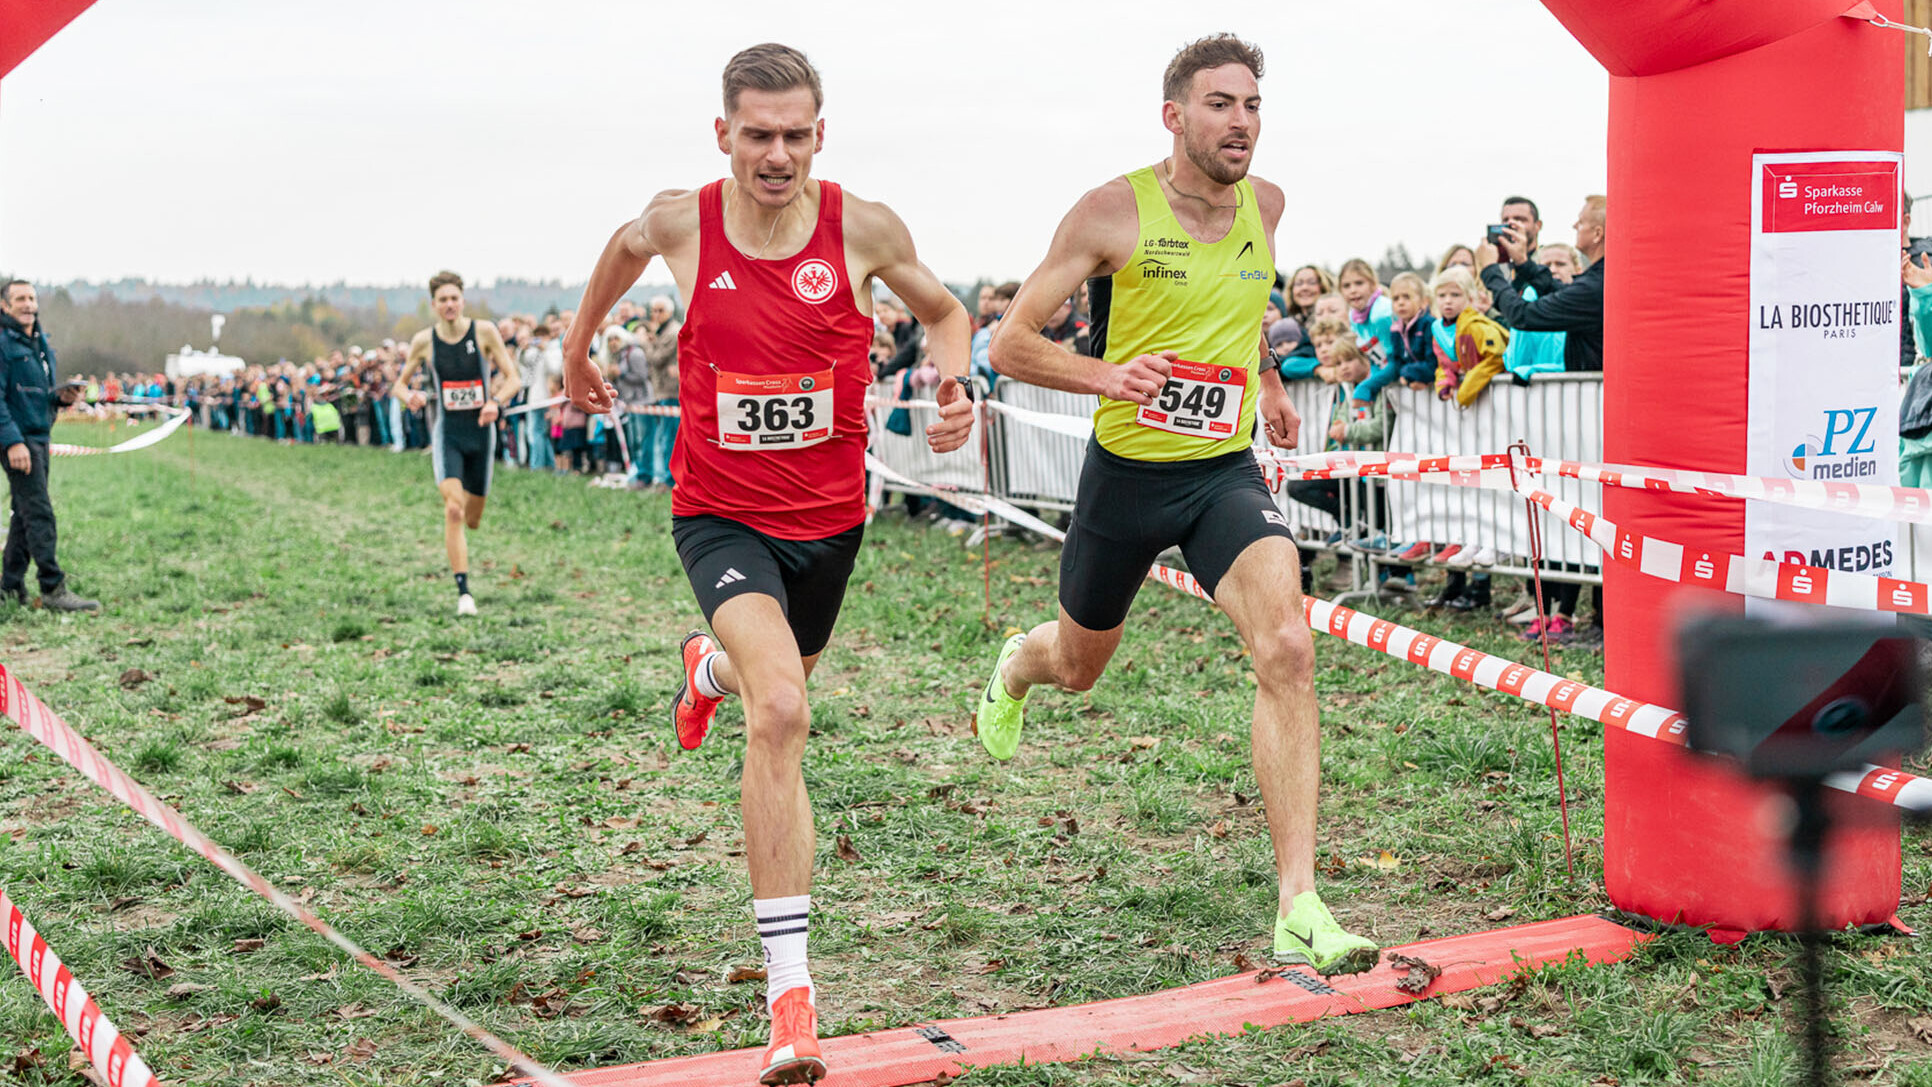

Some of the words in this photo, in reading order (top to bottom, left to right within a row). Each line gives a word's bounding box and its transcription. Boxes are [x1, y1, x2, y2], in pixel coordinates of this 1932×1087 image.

[1804, 184, 1863, 200] Sparkasse
[1804, 202, 1862, 215] Pforzheim
[1863, 200, 1884, 213] Calw
[1143, 239, 1155, 247] LG
[1143, 266, 1188, 279] infinex
[1760, 305, 1783, 329] LA
[1791, 301, 1893, 328] BIOSTHETIQUE
[1823, 328, 1857, 339] PARIS
[1159, 380, 1226, 419] 549
[737, 396, 815, 432] 363
[1817, 406, 1878, 456] PZ
[1813, 456, 1876, 480] medien
